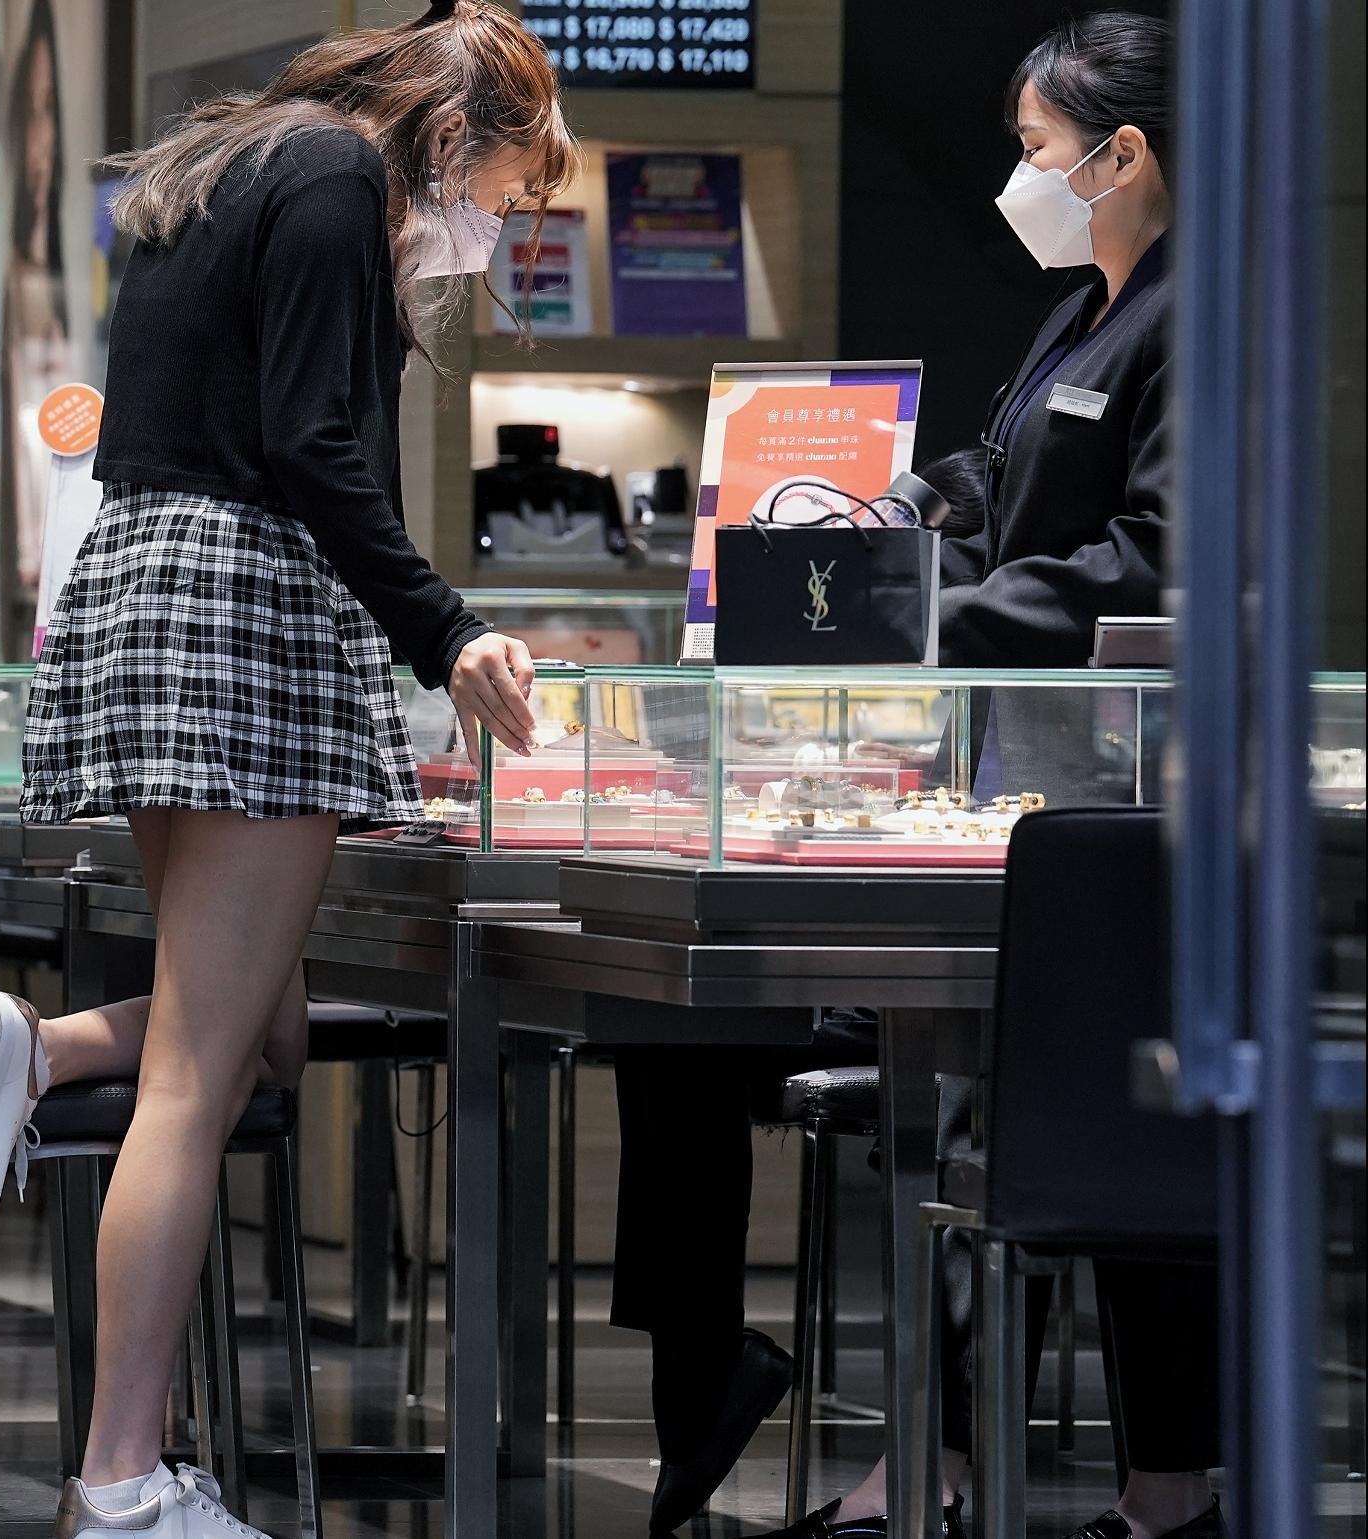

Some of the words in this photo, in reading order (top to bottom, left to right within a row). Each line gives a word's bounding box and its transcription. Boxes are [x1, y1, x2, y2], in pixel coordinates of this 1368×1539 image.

[767, 407, 857, 424] 會員尊享禮遇
[803, 560, 837, 632] YSL
